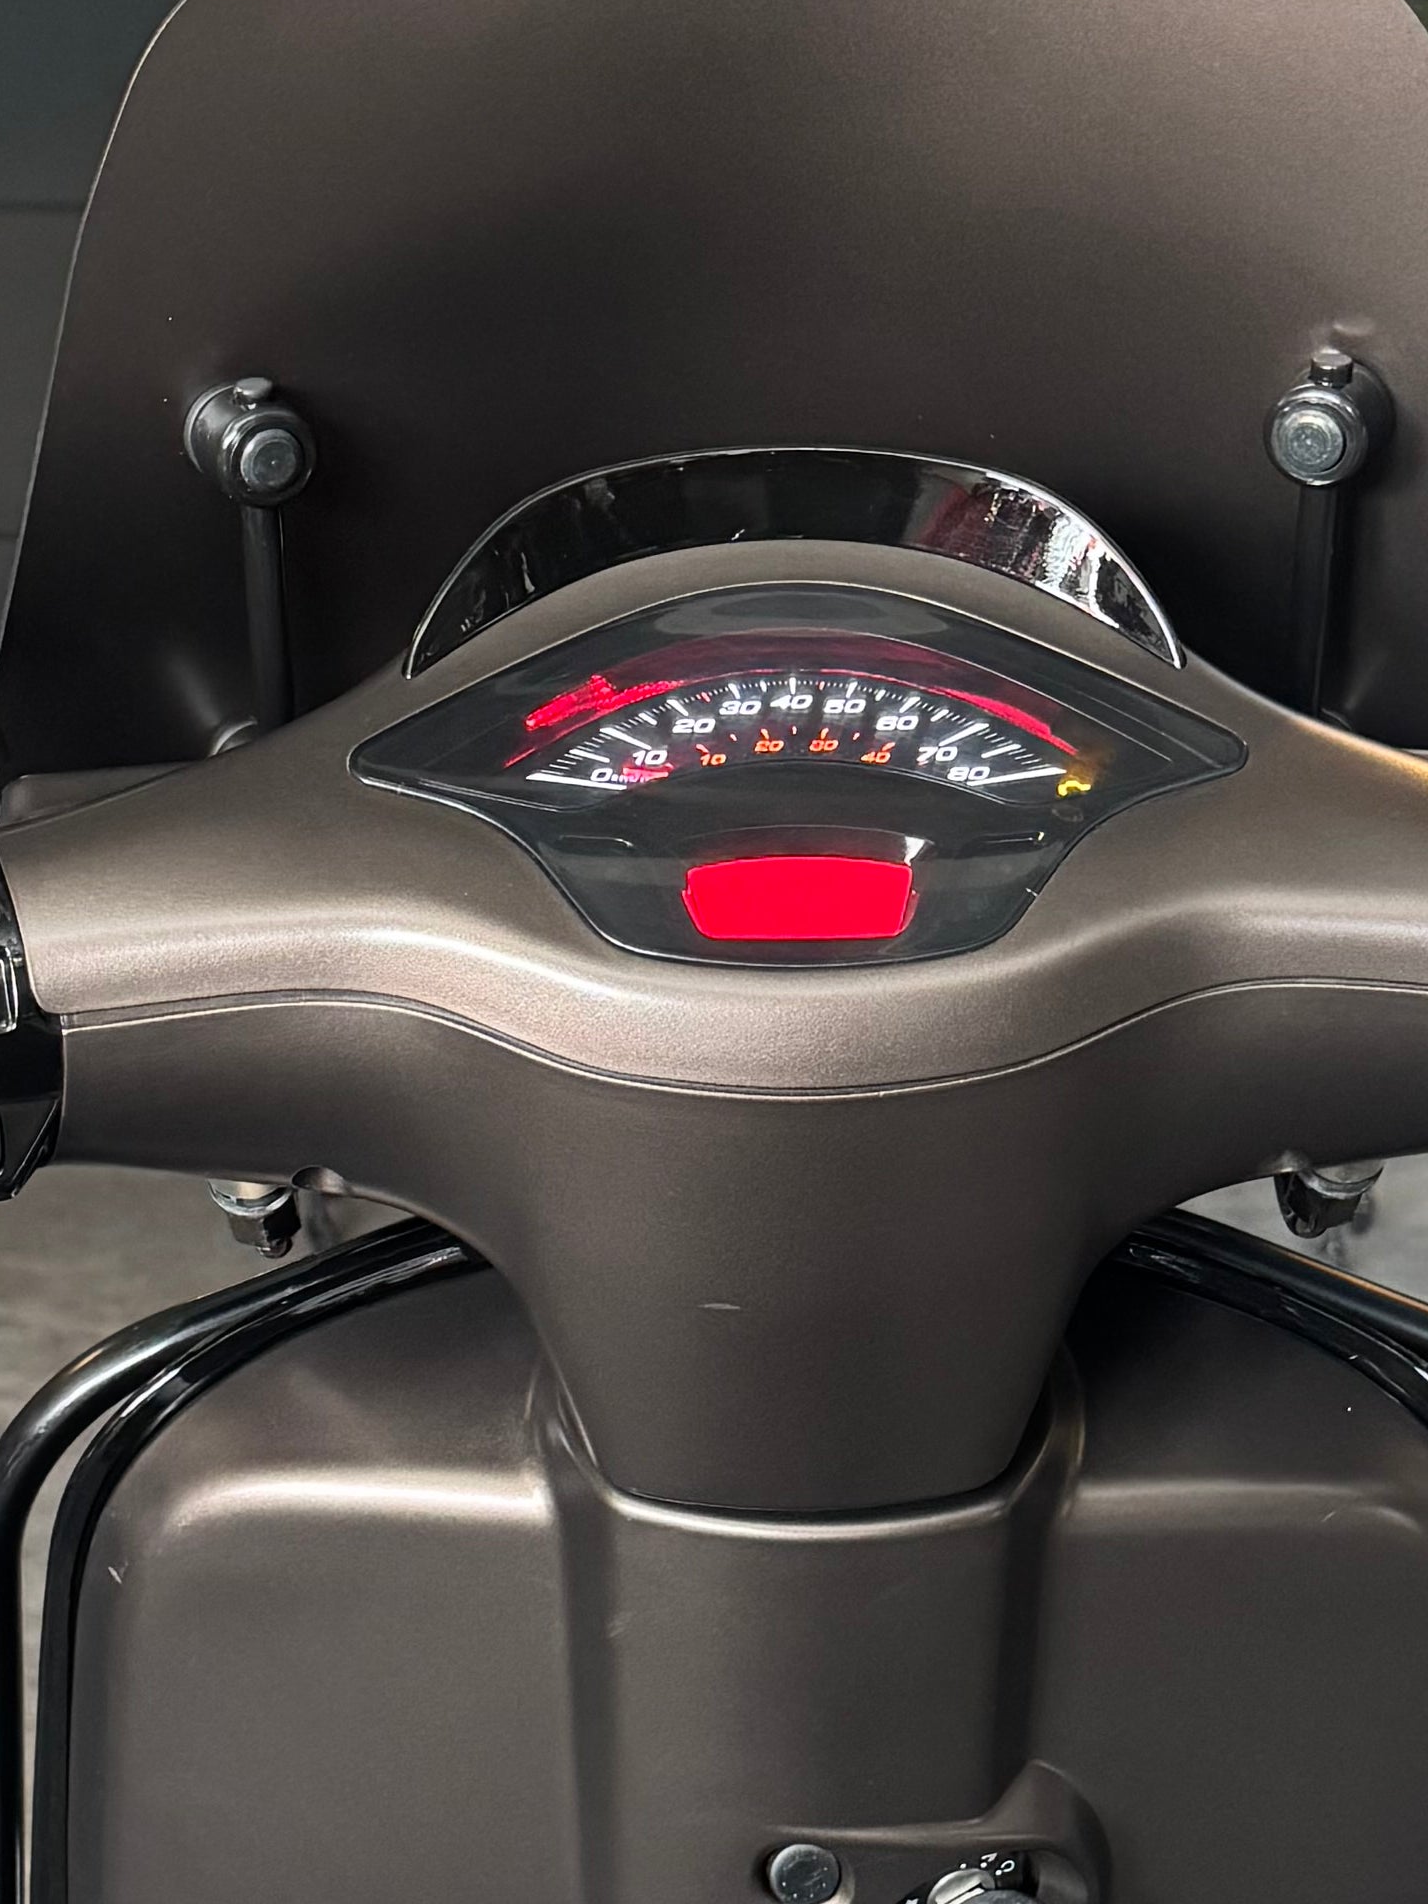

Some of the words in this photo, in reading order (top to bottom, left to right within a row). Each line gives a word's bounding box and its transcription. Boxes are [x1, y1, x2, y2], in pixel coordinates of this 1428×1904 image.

[590, 767, 613, 783] 0
[632, 749, 668, 766] 10
[672, 718, 716, 734] 20
[719, 700, 762, 715] 30
[770, 694, 814, 711] 40
[823, 698, 867, 714] 50
[875, 715, 919, 732] 60
[917, 746, 958, 764] 70
[947, 766, 990, 782] 80
[700, 753, 727, 767] 10
[754, 739, 785, 753] 20
[861, 751, 892, 765] 40
